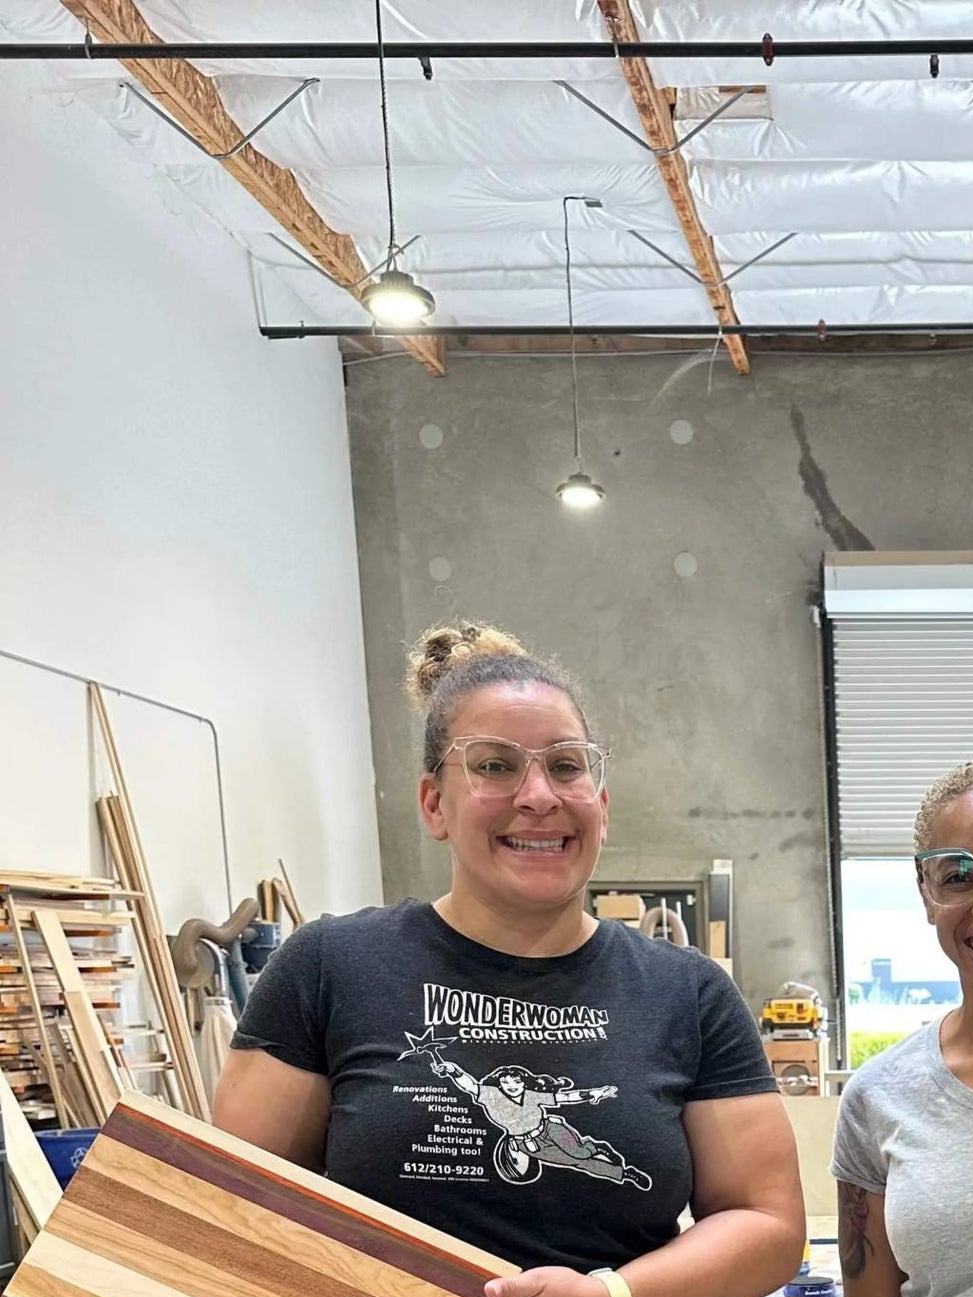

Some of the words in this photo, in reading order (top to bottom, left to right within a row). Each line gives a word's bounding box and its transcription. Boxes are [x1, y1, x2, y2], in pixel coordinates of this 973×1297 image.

[423, 983, 609, 1029] WONDERWOMAN
[459, 1026, 608, 1041] CONSTRUCTION!
[392, 1085, 448, 1093] Renovations
[412, 1094, 458, 1103] Additions
[428, 1104, 469, 1114] Kitchens
[444, 1114, 472, 1124] Decks
[434, 1124, 487, 1136] Bathrooms
[427, 1134, 473, 1145] Electrical
[476, 1137, 484, 1146] &
[411, 1143, 458, 1156] Plumbing
[404, 1162, 484, 1176] 612/210-9220
